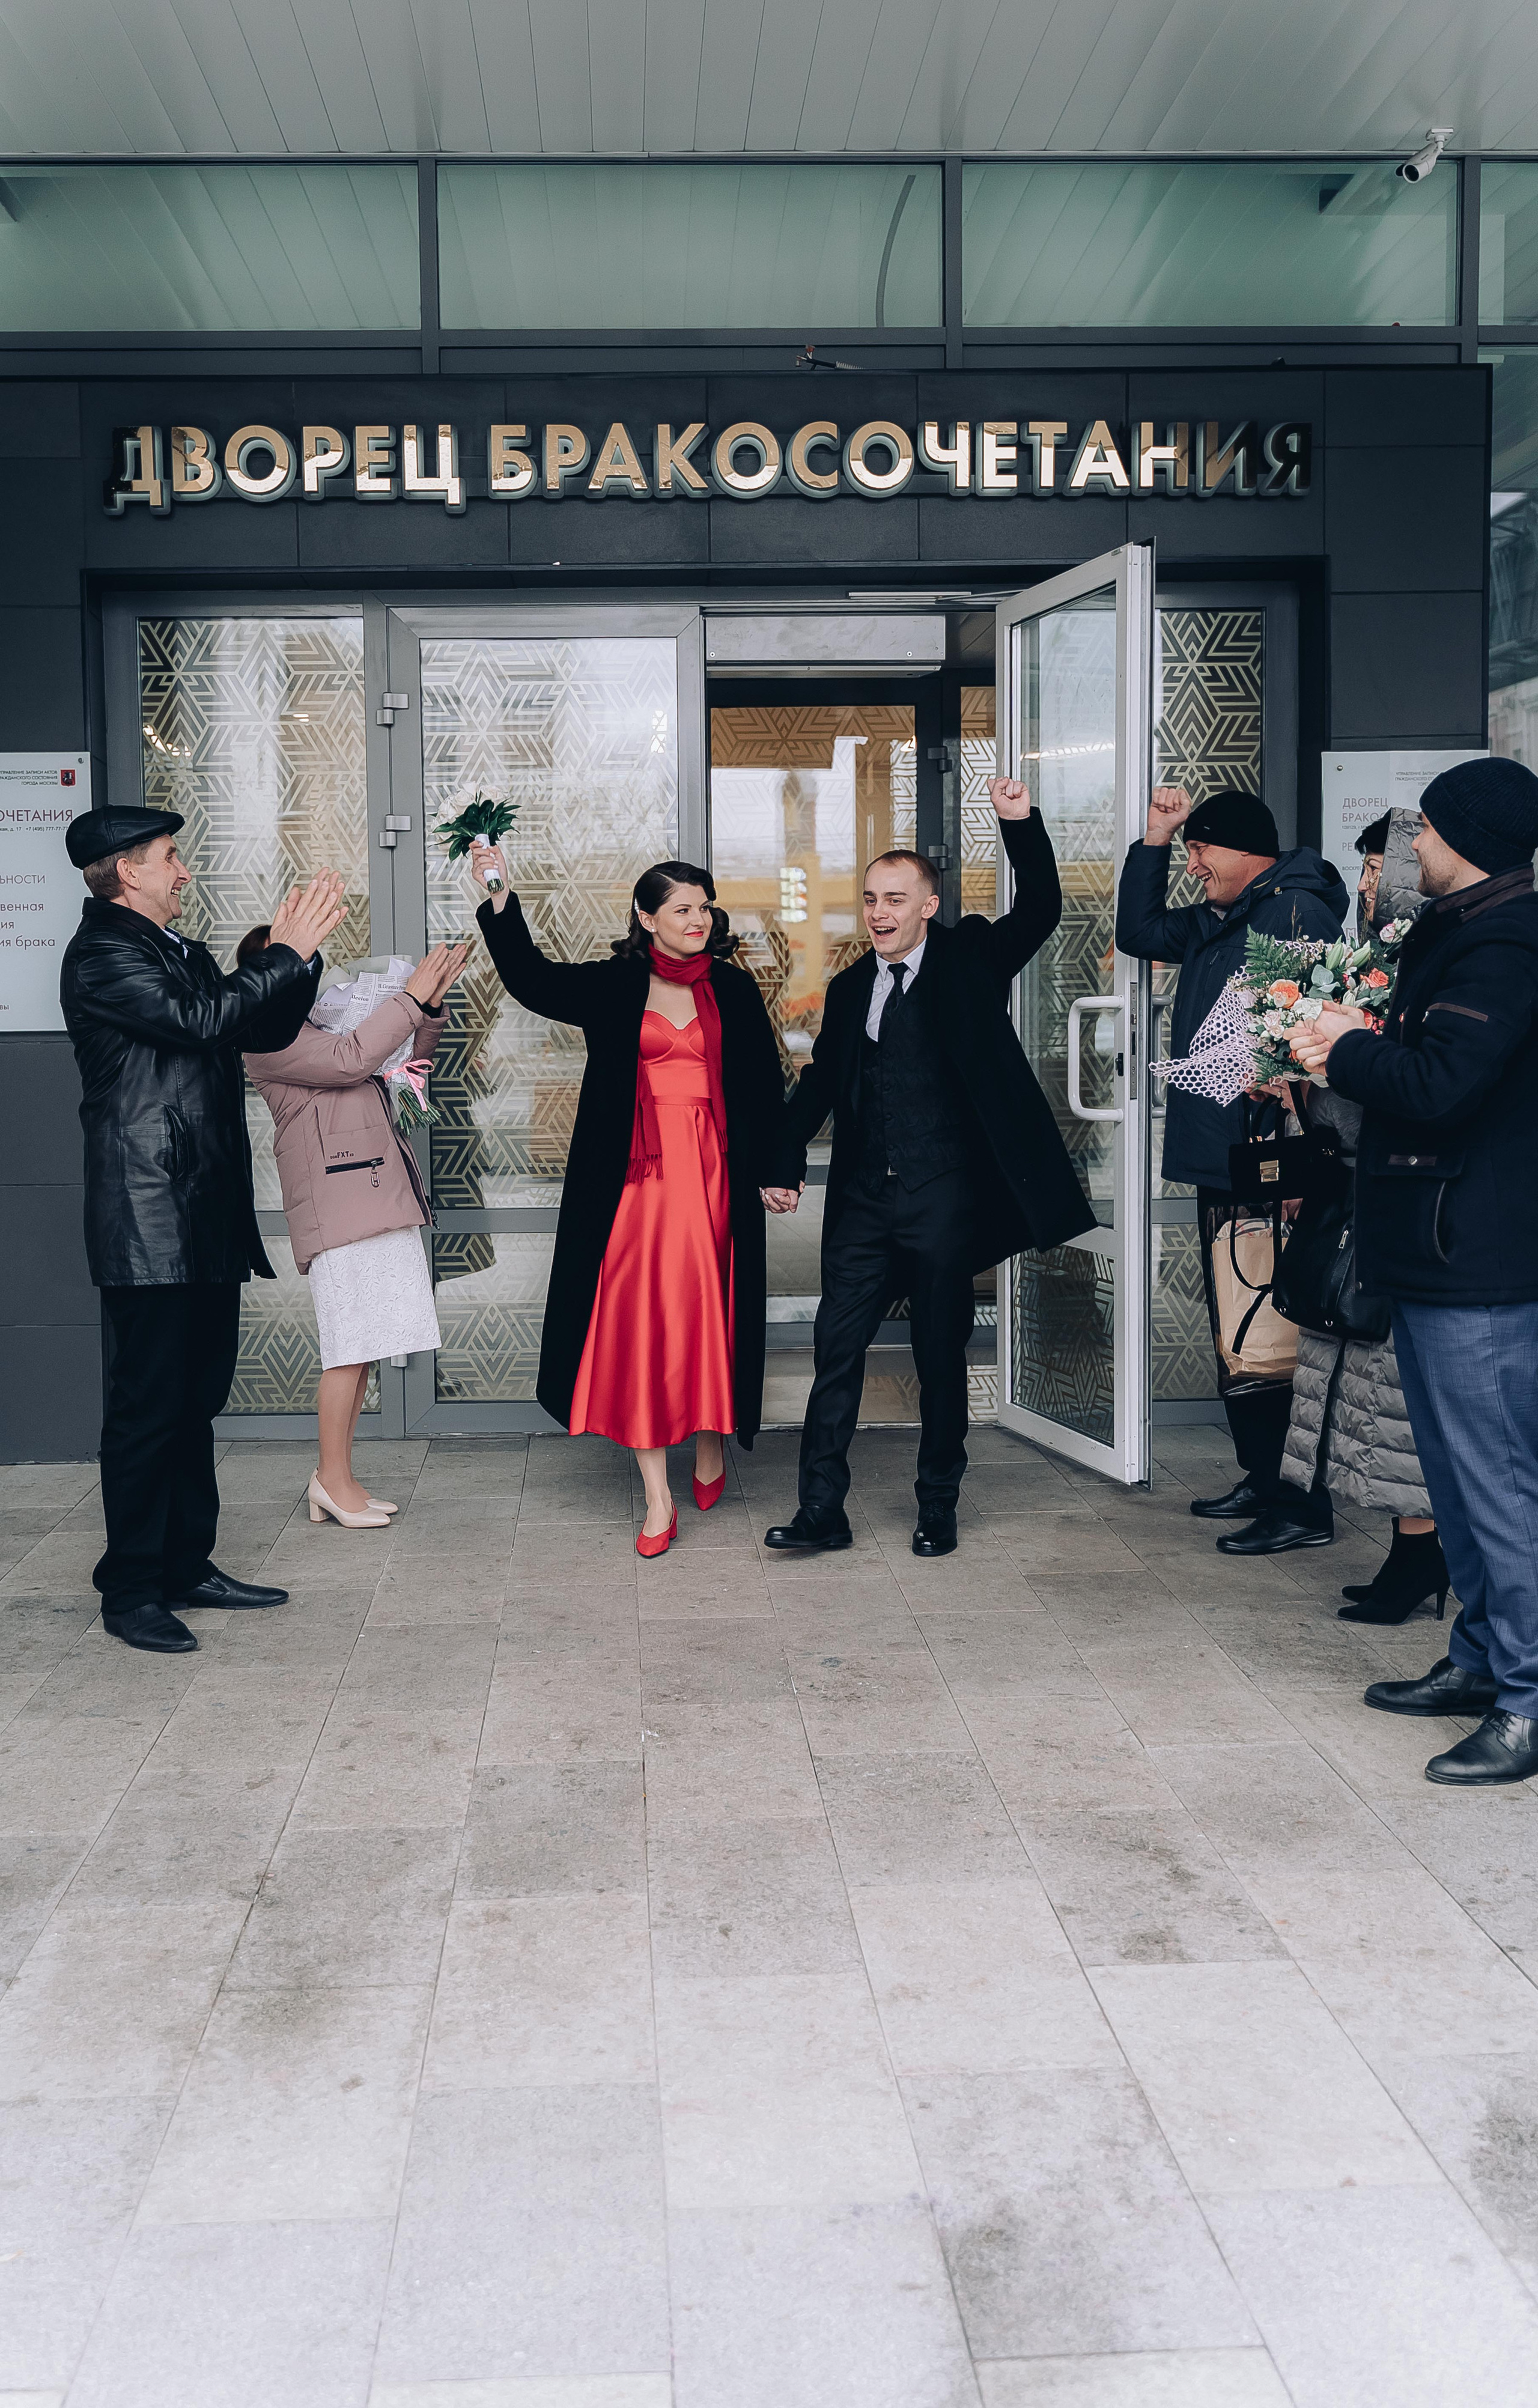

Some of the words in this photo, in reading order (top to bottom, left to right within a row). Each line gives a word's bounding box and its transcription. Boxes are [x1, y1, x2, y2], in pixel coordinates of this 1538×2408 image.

[103, 424, 461, 509] ДВОРЕЦ
[488, 421, 1312, 496] БРАКОСОЧЕТАНИЯ
[1342, 798, 1388, 809] ДВОРЕЦ
[16, 935, 55, 950] брака
